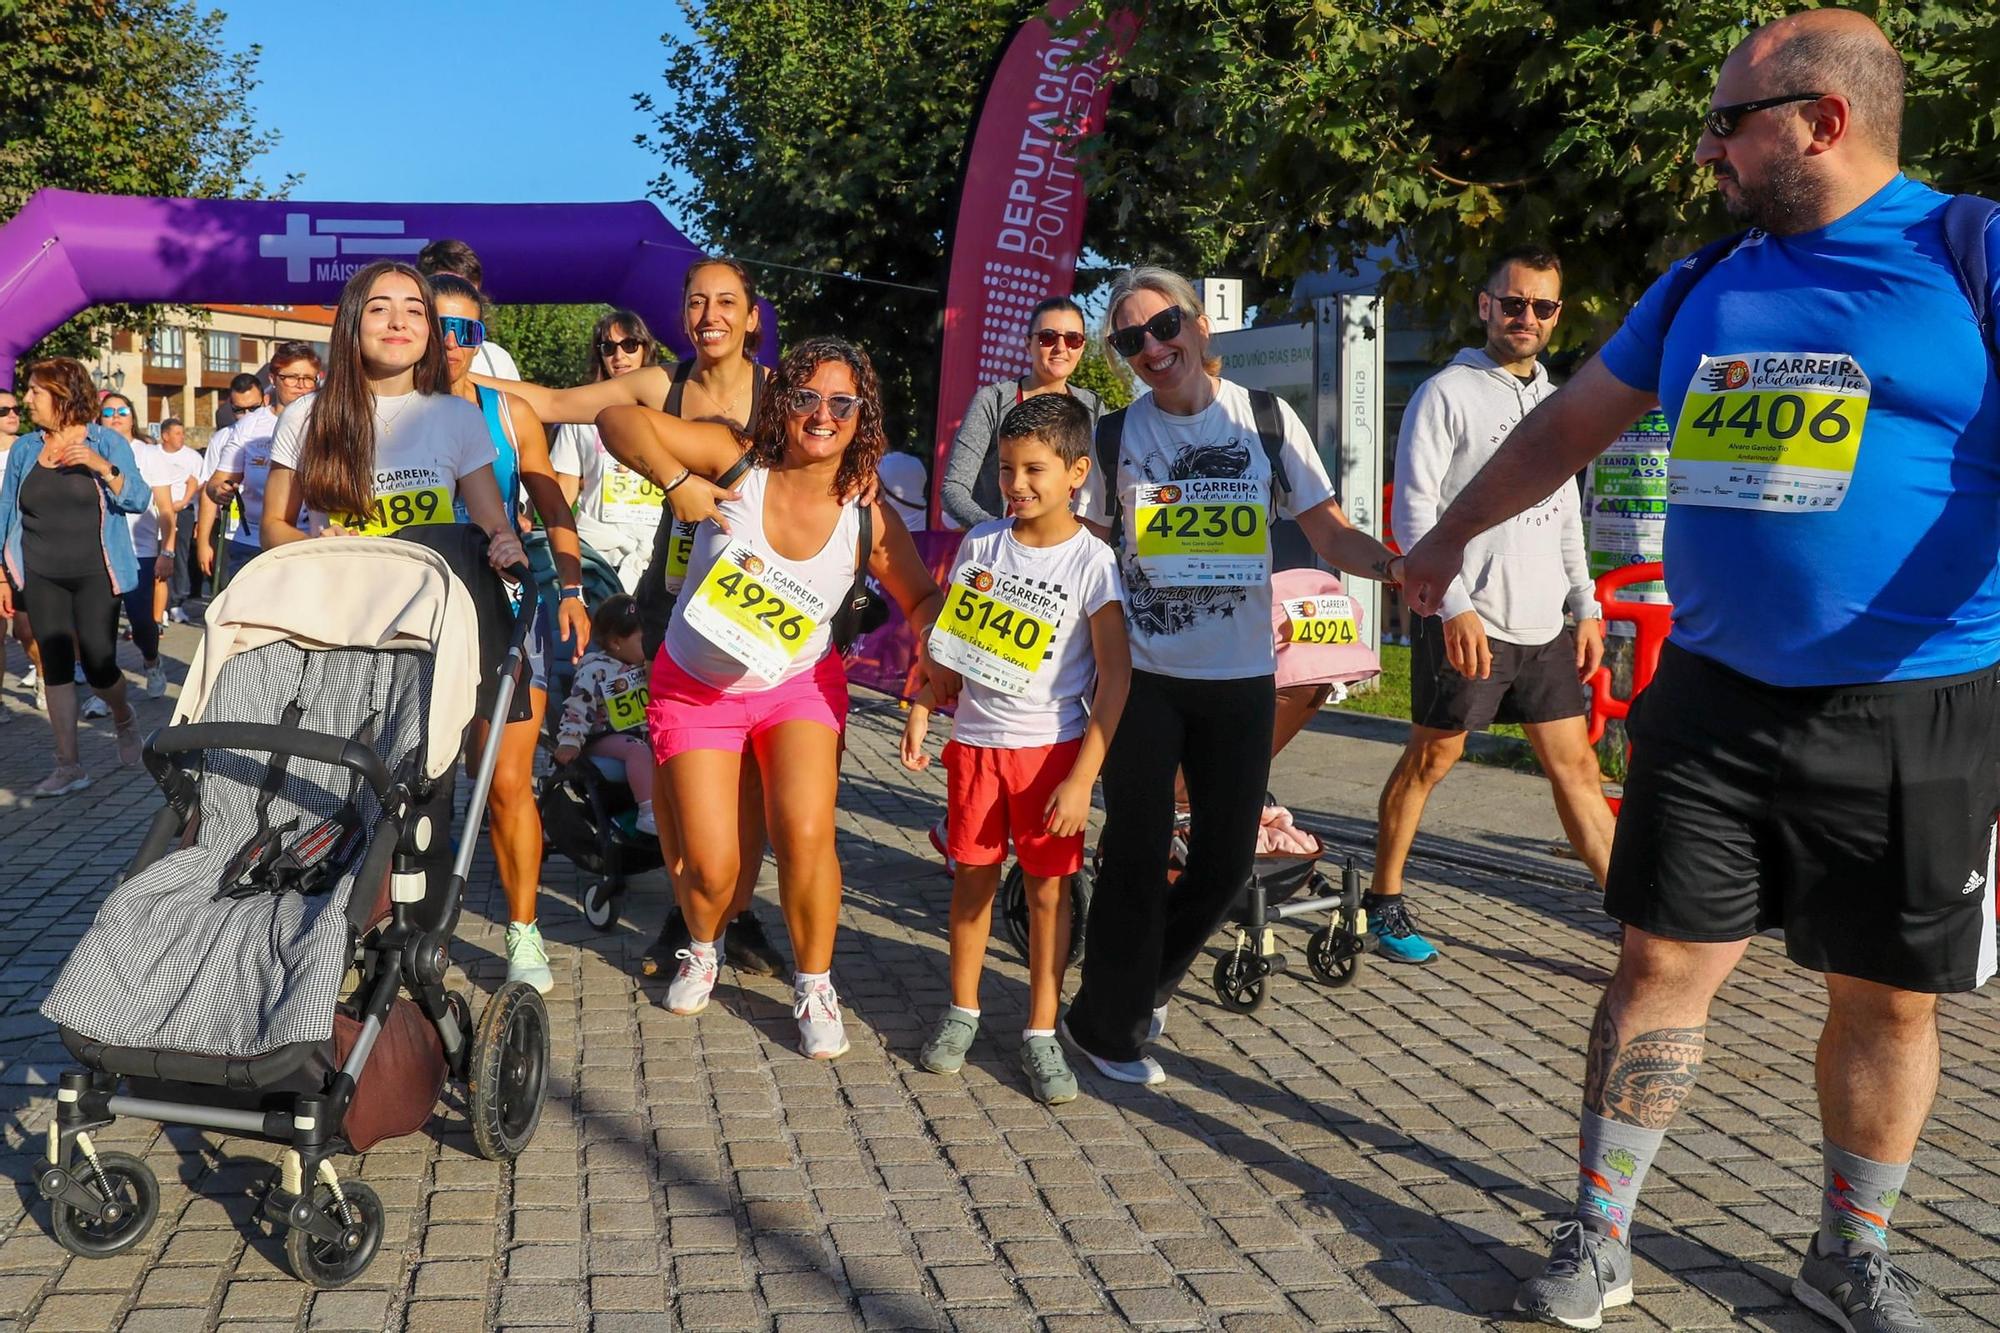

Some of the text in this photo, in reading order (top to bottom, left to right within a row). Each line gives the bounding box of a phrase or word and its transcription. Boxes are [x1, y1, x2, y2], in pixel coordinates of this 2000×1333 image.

[316, 260, 368, 282] MÁISI
[1352, 370, 1372, 444] galicia
[1692, 394, 1851, 444] 4406
[1640, 457, 1658, 467] DO
[1185, 481, 1259, 493] I CARREIRA
[343, 490, 439, 532] 4189
[1146, 505, 1258, 539] 4230
[717, 572, 805, 641] 4926
[773, 571, 825, 610] CARREIRA
[1002, 580, 1058, 611] CARREIRA
[955, 589, 1041, 651] 5140
[1298, 620, 1354, 644] 4924
